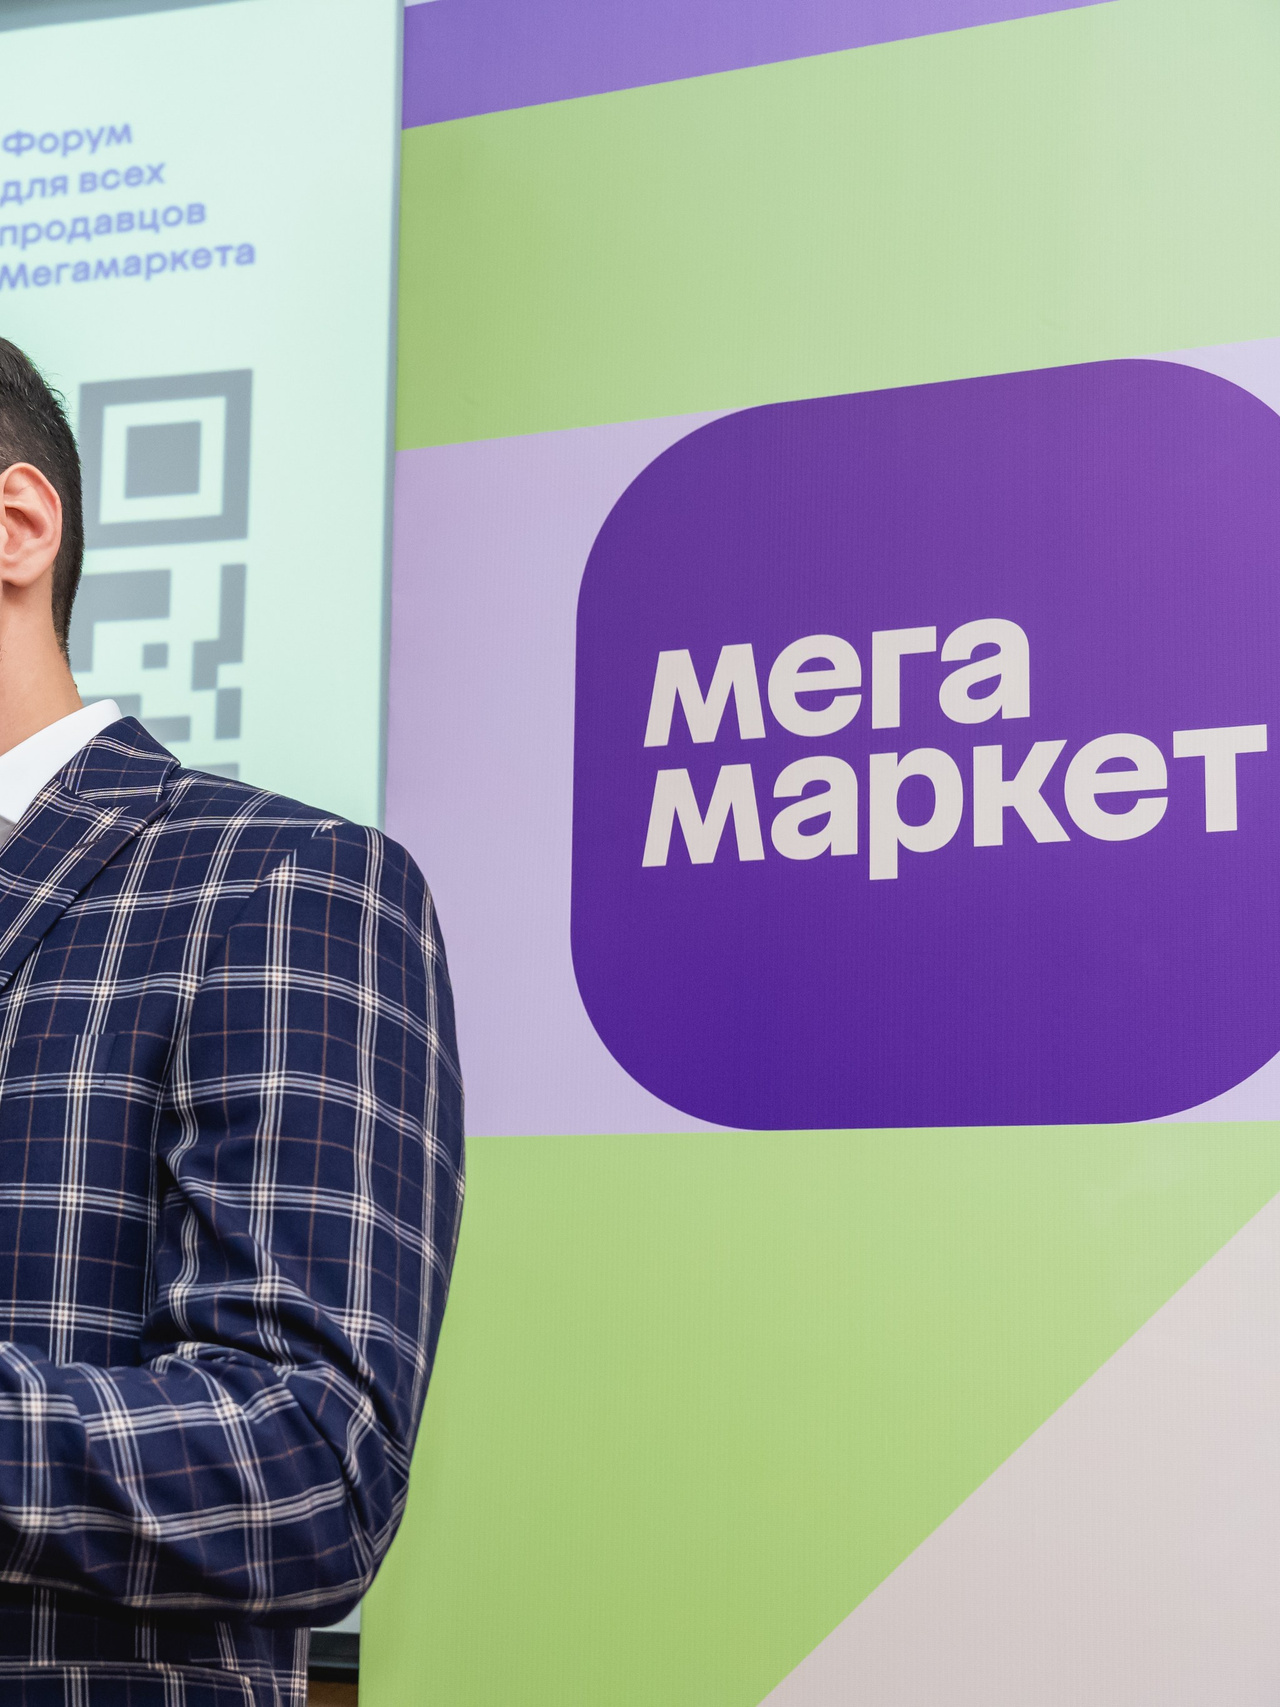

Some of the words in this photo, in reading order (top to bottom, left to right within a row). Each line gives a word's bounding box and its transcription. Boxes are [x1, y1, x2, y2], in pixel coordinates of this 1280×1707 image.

[1, 123, 133, 157] Форум
[0, 174, 69, 207] для
[78, 162, 166, 194] всех
[643, 617, 1031, 748] мега
[641, 723, 1268, 881] маркет
